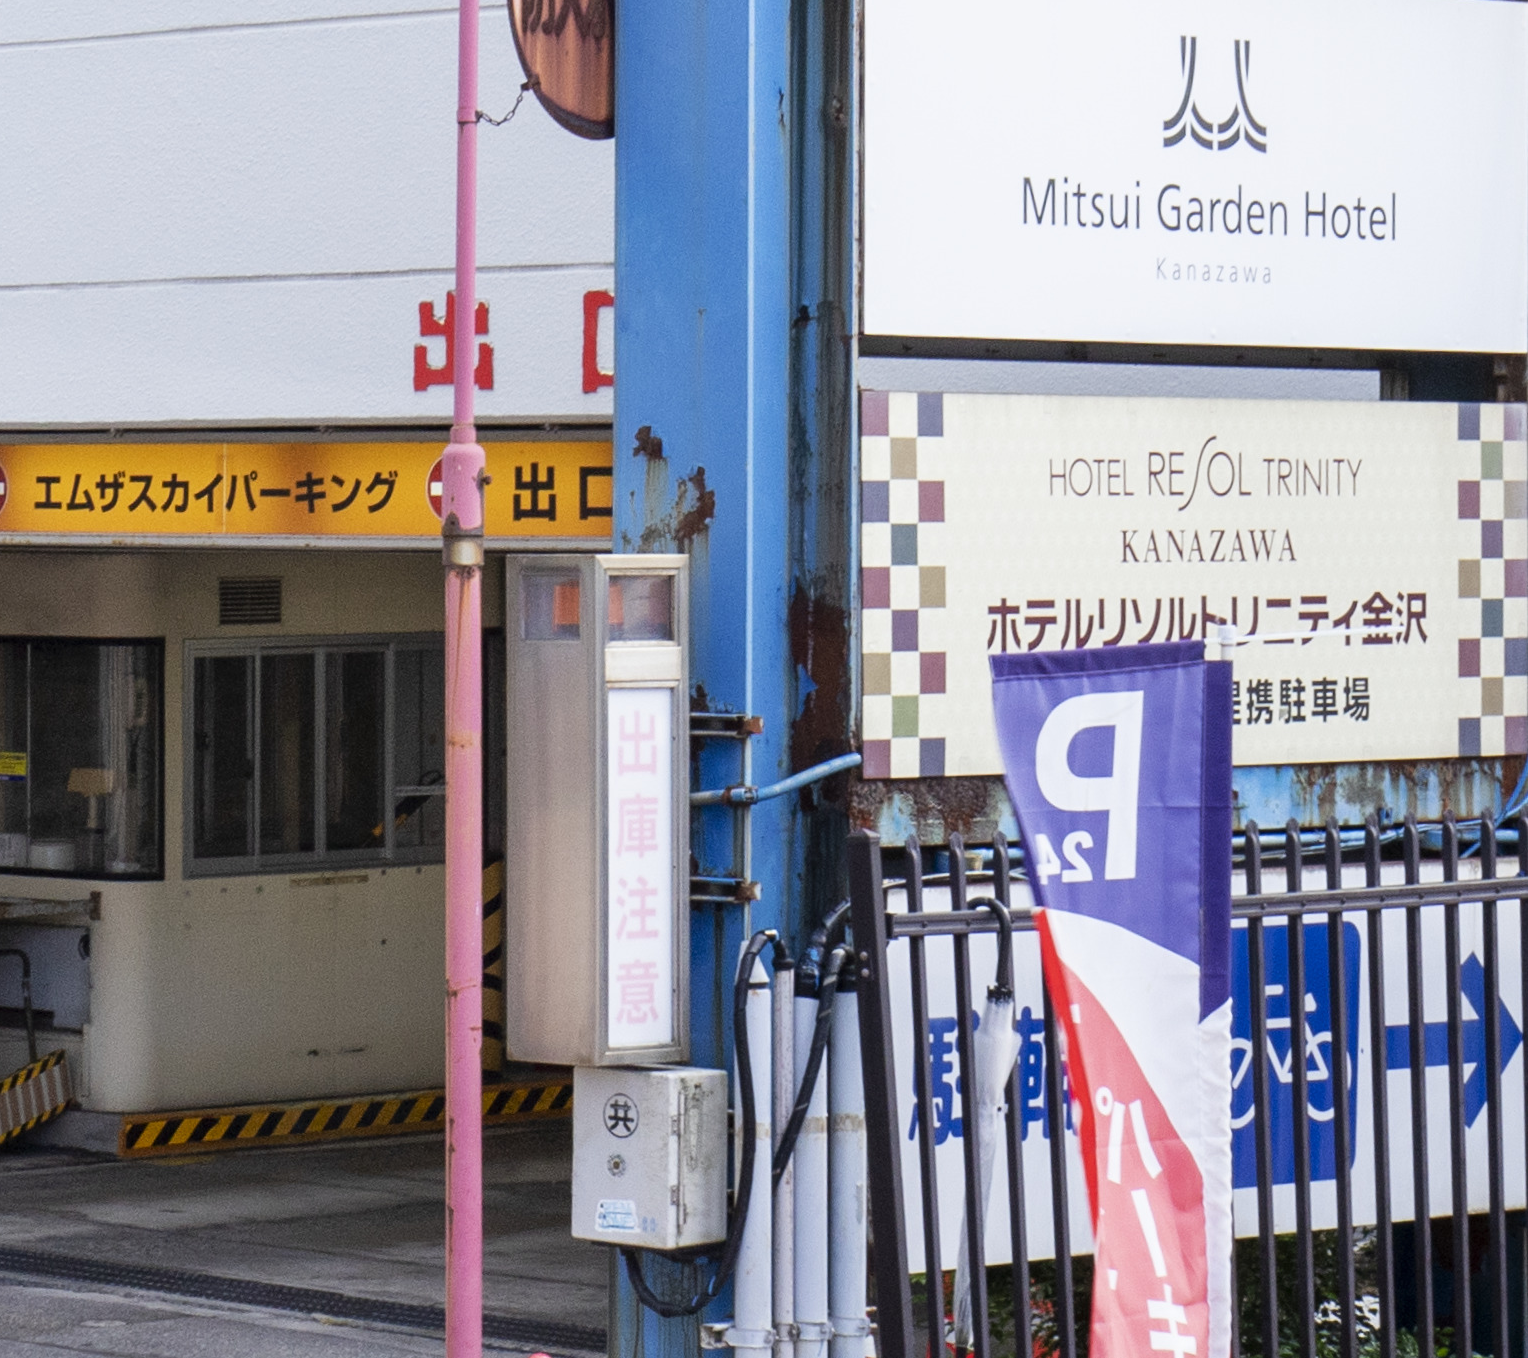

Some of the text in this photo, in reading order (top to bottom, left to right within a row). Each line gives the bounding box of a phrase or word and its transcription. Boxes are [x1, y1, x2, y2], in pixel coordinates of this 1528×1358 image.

[1022, 176, 1397, 241] Mitsui Garden Hotel
[1156, 257, 1272, 285] Kanazawa
[34, 469, 398, 515] エムザスカイパーキング
[1049, 435, 1363, 511] HOTEL RESOL TRINITY
[1120, 529, 1297, 564] KANAZAWA
[987, 591, 1428, 652] ホテルリソルトリニティ金沢
[617, 710, 659, 1025] 出庫注意
